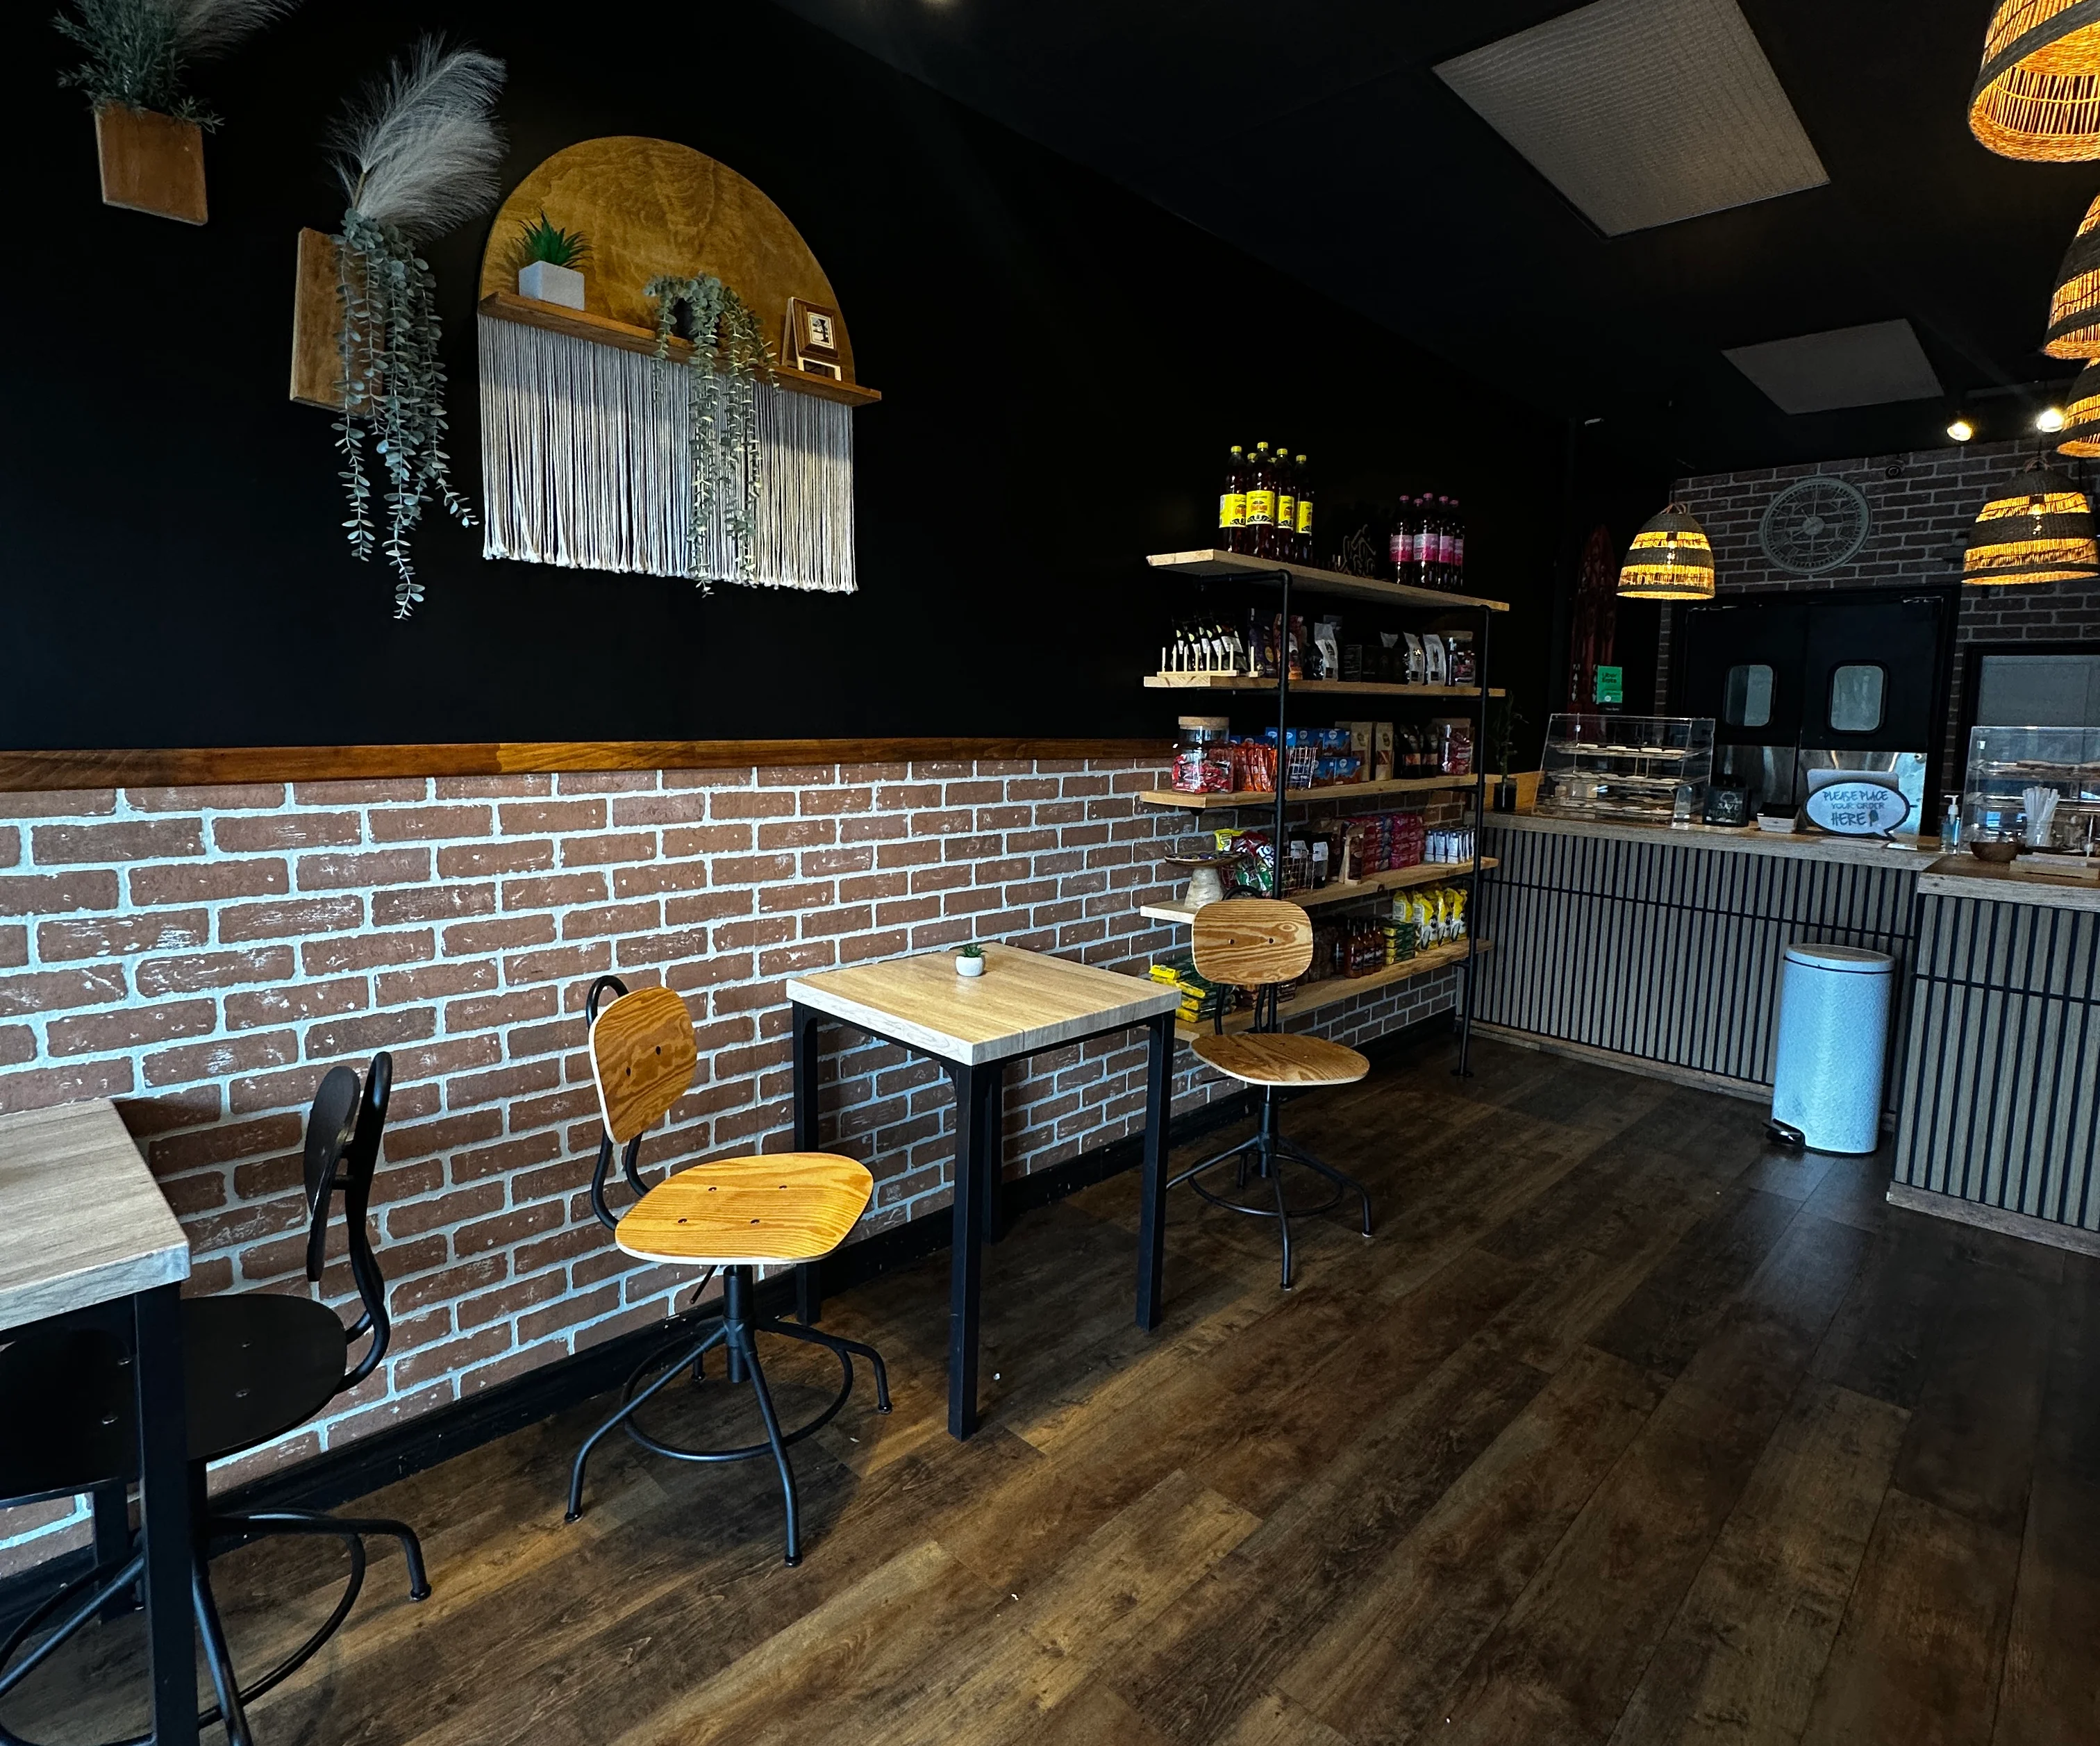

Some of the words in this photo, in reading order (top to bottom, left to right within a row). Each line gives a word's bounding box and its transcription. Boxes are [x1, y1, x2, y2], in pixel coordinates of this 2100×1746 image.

[1822, 790, 1858, 801] PLEASE
[1858, 790, 1889, 801] PLACE
[1831, 811, 1867, 826] HERE
